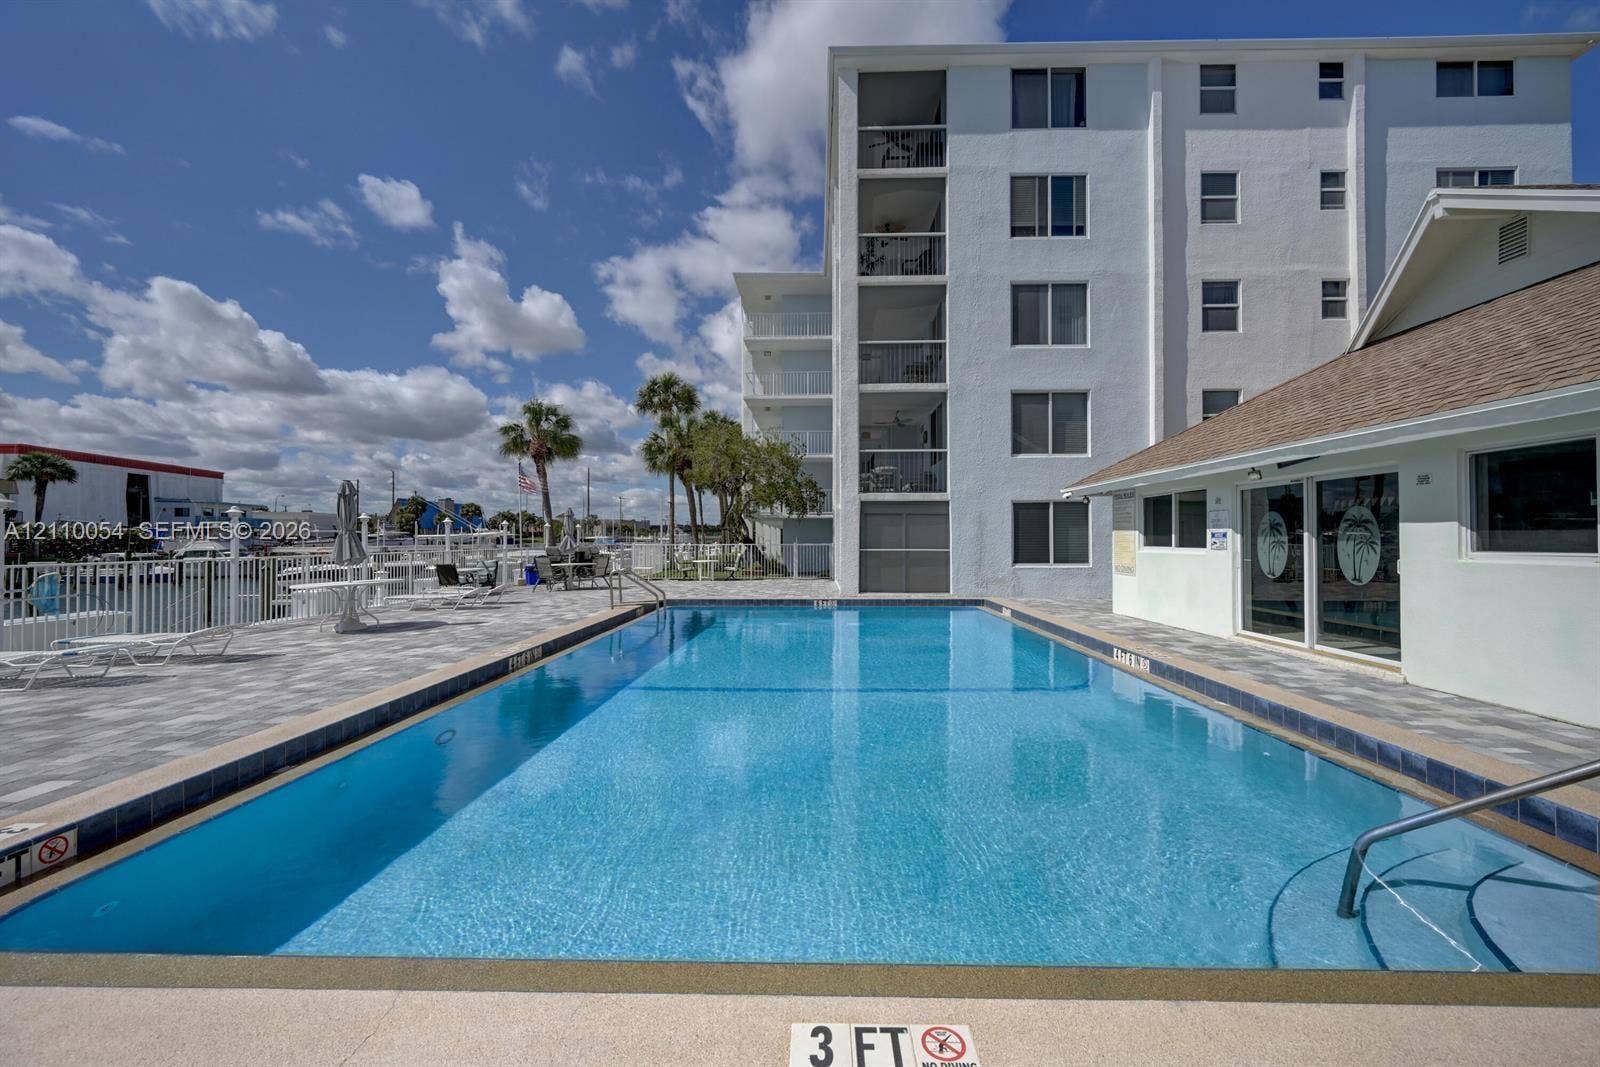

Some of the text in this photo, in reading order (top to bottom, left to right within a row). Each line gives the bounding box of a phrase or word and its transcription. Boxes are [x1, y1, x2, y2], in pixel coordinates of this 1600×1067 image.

[0, 847, 30, 884] T
[809, 1025, 909, 1067] 3 FT
